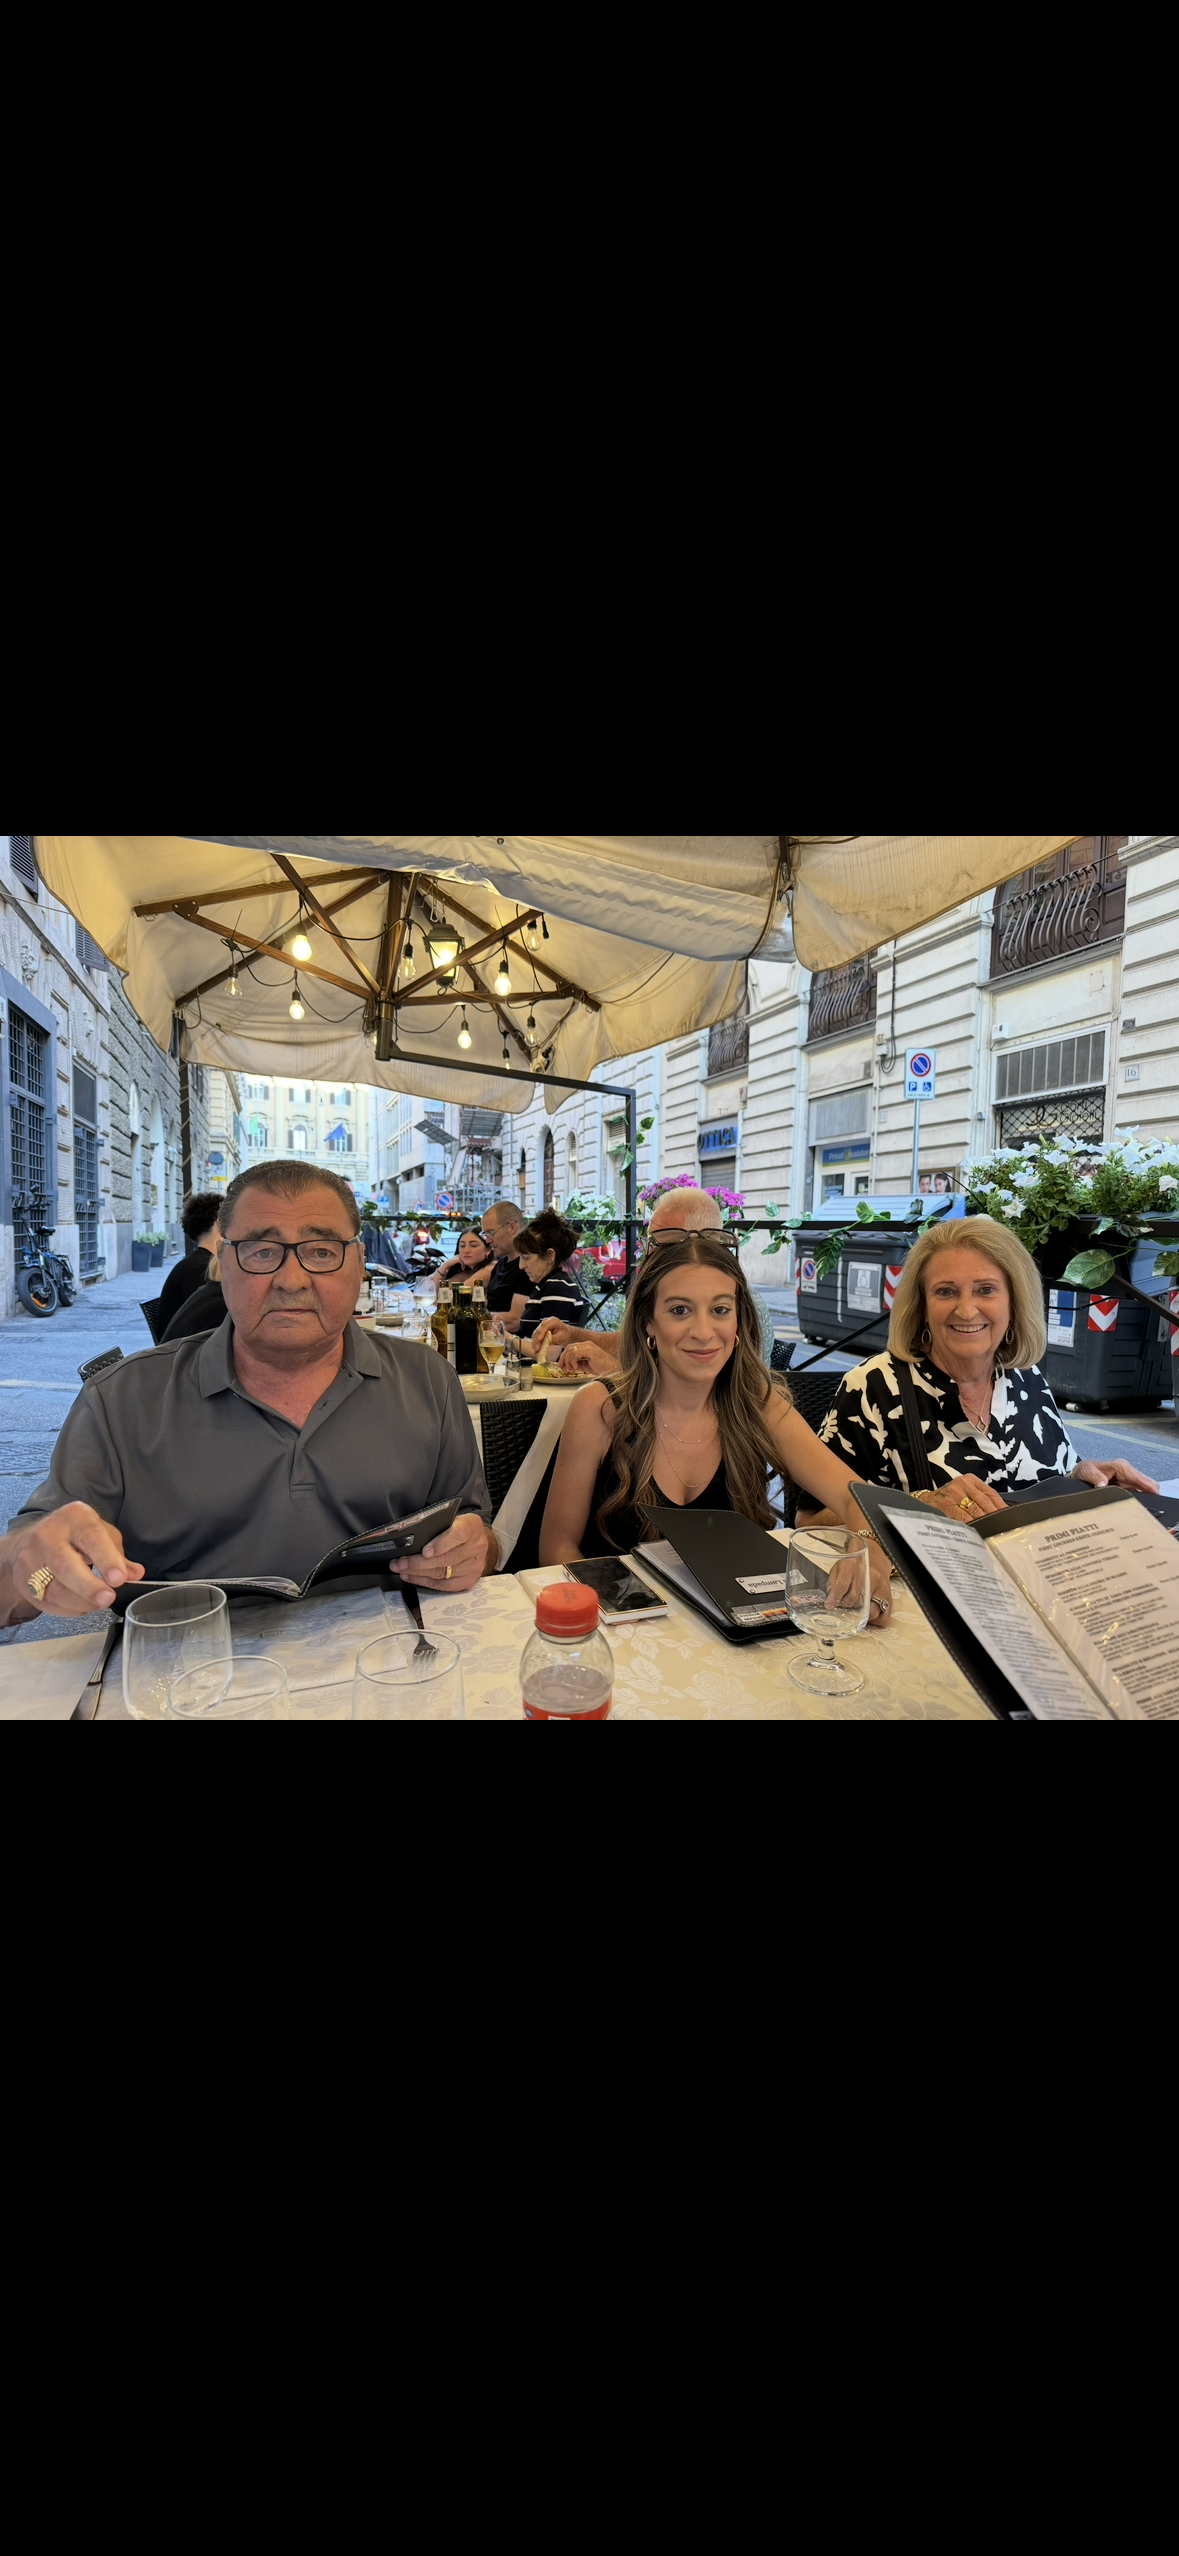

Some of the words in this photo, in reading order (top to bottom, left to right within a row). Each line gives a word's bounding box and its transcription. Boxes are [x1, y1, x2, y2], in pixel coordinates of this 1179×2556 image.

[1127, 1067, 1137, 1077] 16
[697, 1126, 734, 1150] OTTICA
[1044, 1530, 1070, 1542] PRIMI
[1070, 1523, 1099, 1535] PIATTI
[747, 1579, 784, 1589] Lampada
